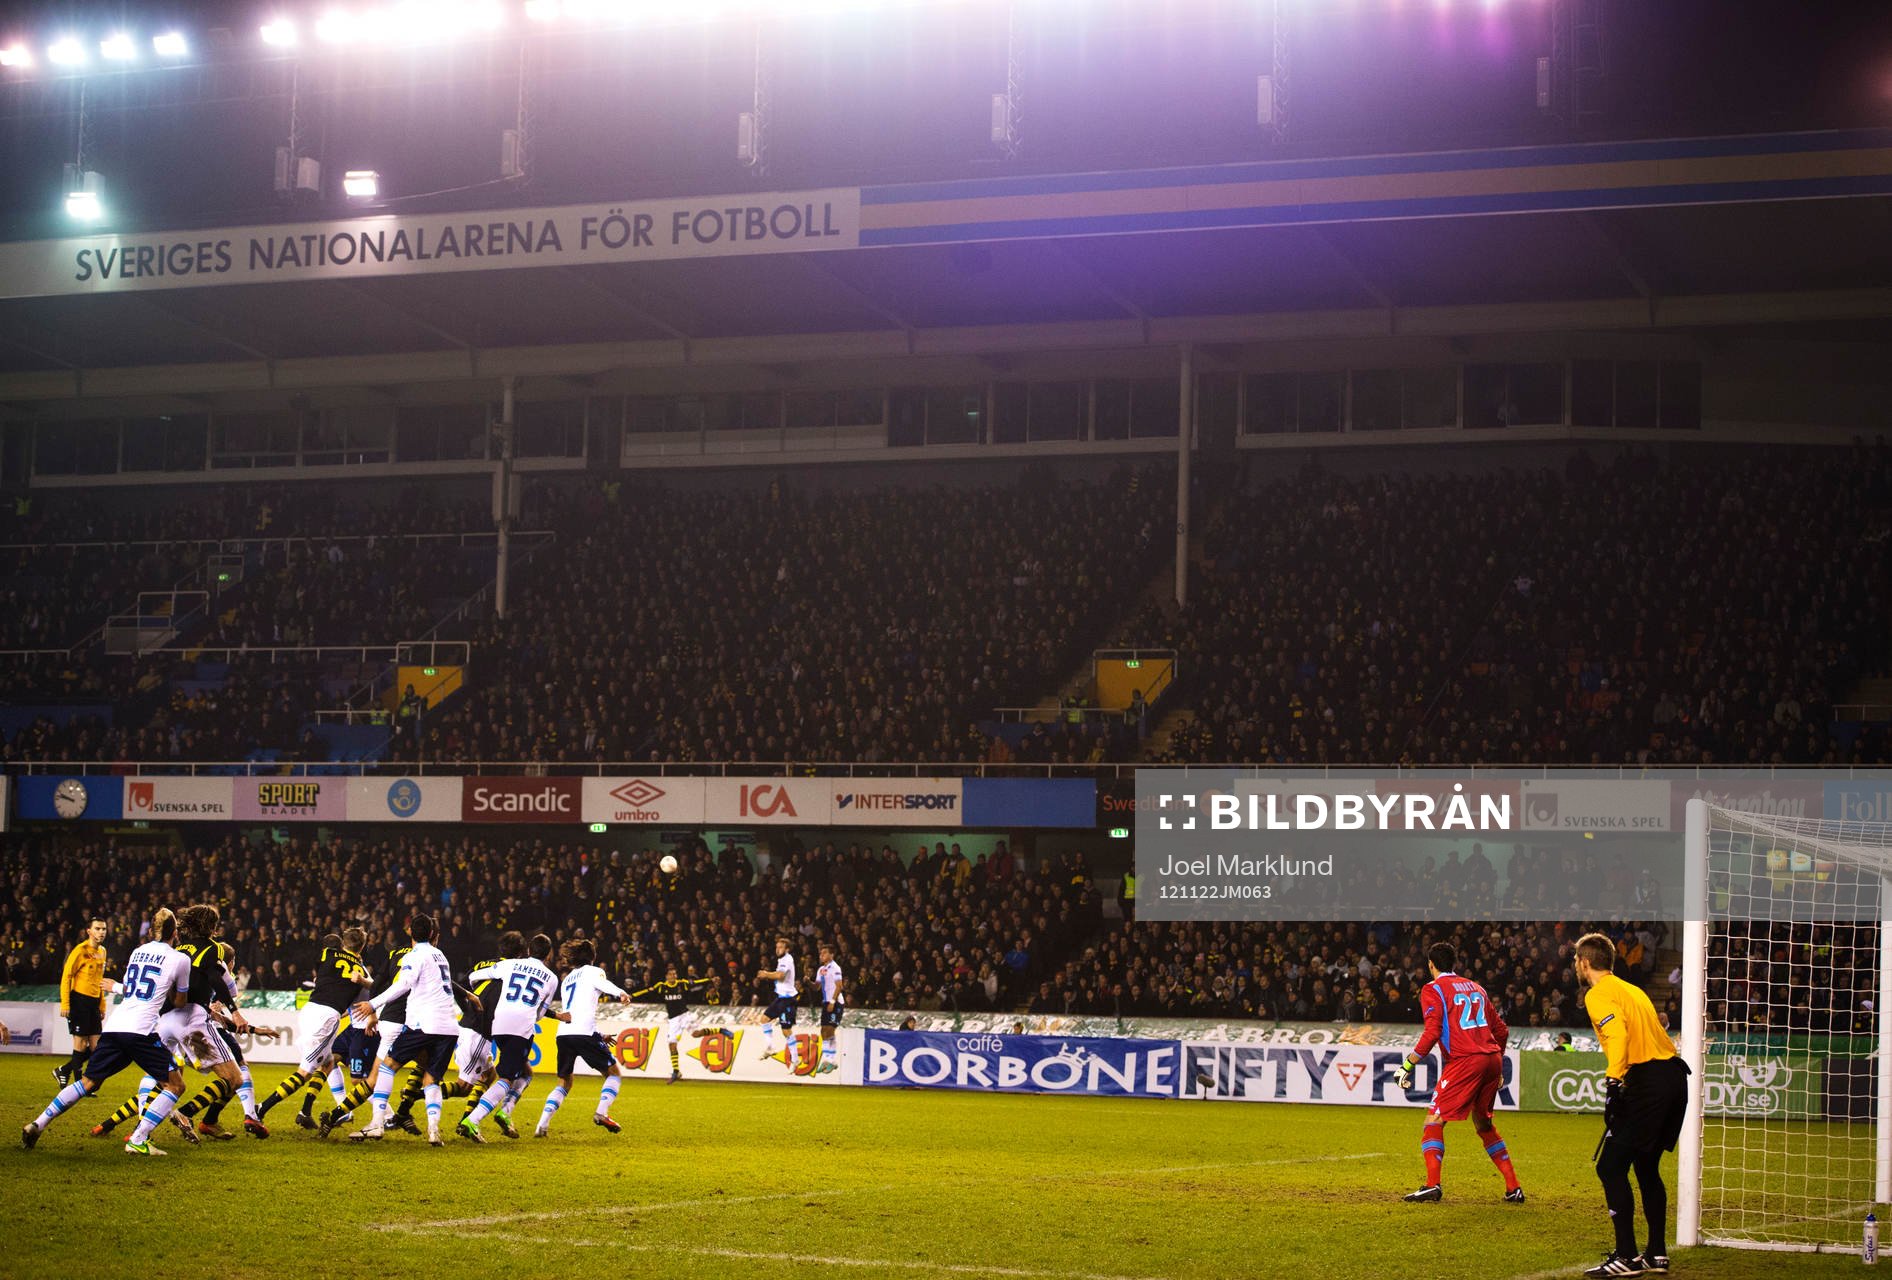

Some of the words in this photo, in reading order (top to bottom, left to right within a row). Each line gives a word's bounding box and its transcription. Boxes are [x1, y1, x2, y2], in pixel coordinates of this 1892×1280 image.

[75, 240, 232, 281] SVERIGES
[249, 219, 563, 270] NATIONALARENA
[580, 208, 654, 250] FÖR
[672, 202, 840, 245] FOTBOLL
[258, 783, 320, 807] SPORT
[473, 787, 571, 812] Scandic
[739, 784, 798, 817] ICA
[855, 794, 957, 810] INTERSPORT
[154, 803, 197, 813] SVENSKA
[201, 803, 224, 813] SPEL
[261, 807, 318, 815] BLADET
[615, 809, 660, 821] umbro
[1564, 816, 1627, 828] SVENSKA
[1632, 816, 1665, 828] SPEL
[124, 963, 162, 1001] 85
[506, 972, 545, 1008] 55
[566, 982, 577, 1010] 7
[1454, 992, 1489, 1030] 22
[957, 1034, 1003, 1052] caffè
[350, 1057, 363, 1072] 16
[869, 1038, 1174, 1095] BORBONE
[1185, 1045, 1341, 1100] FIFTY
